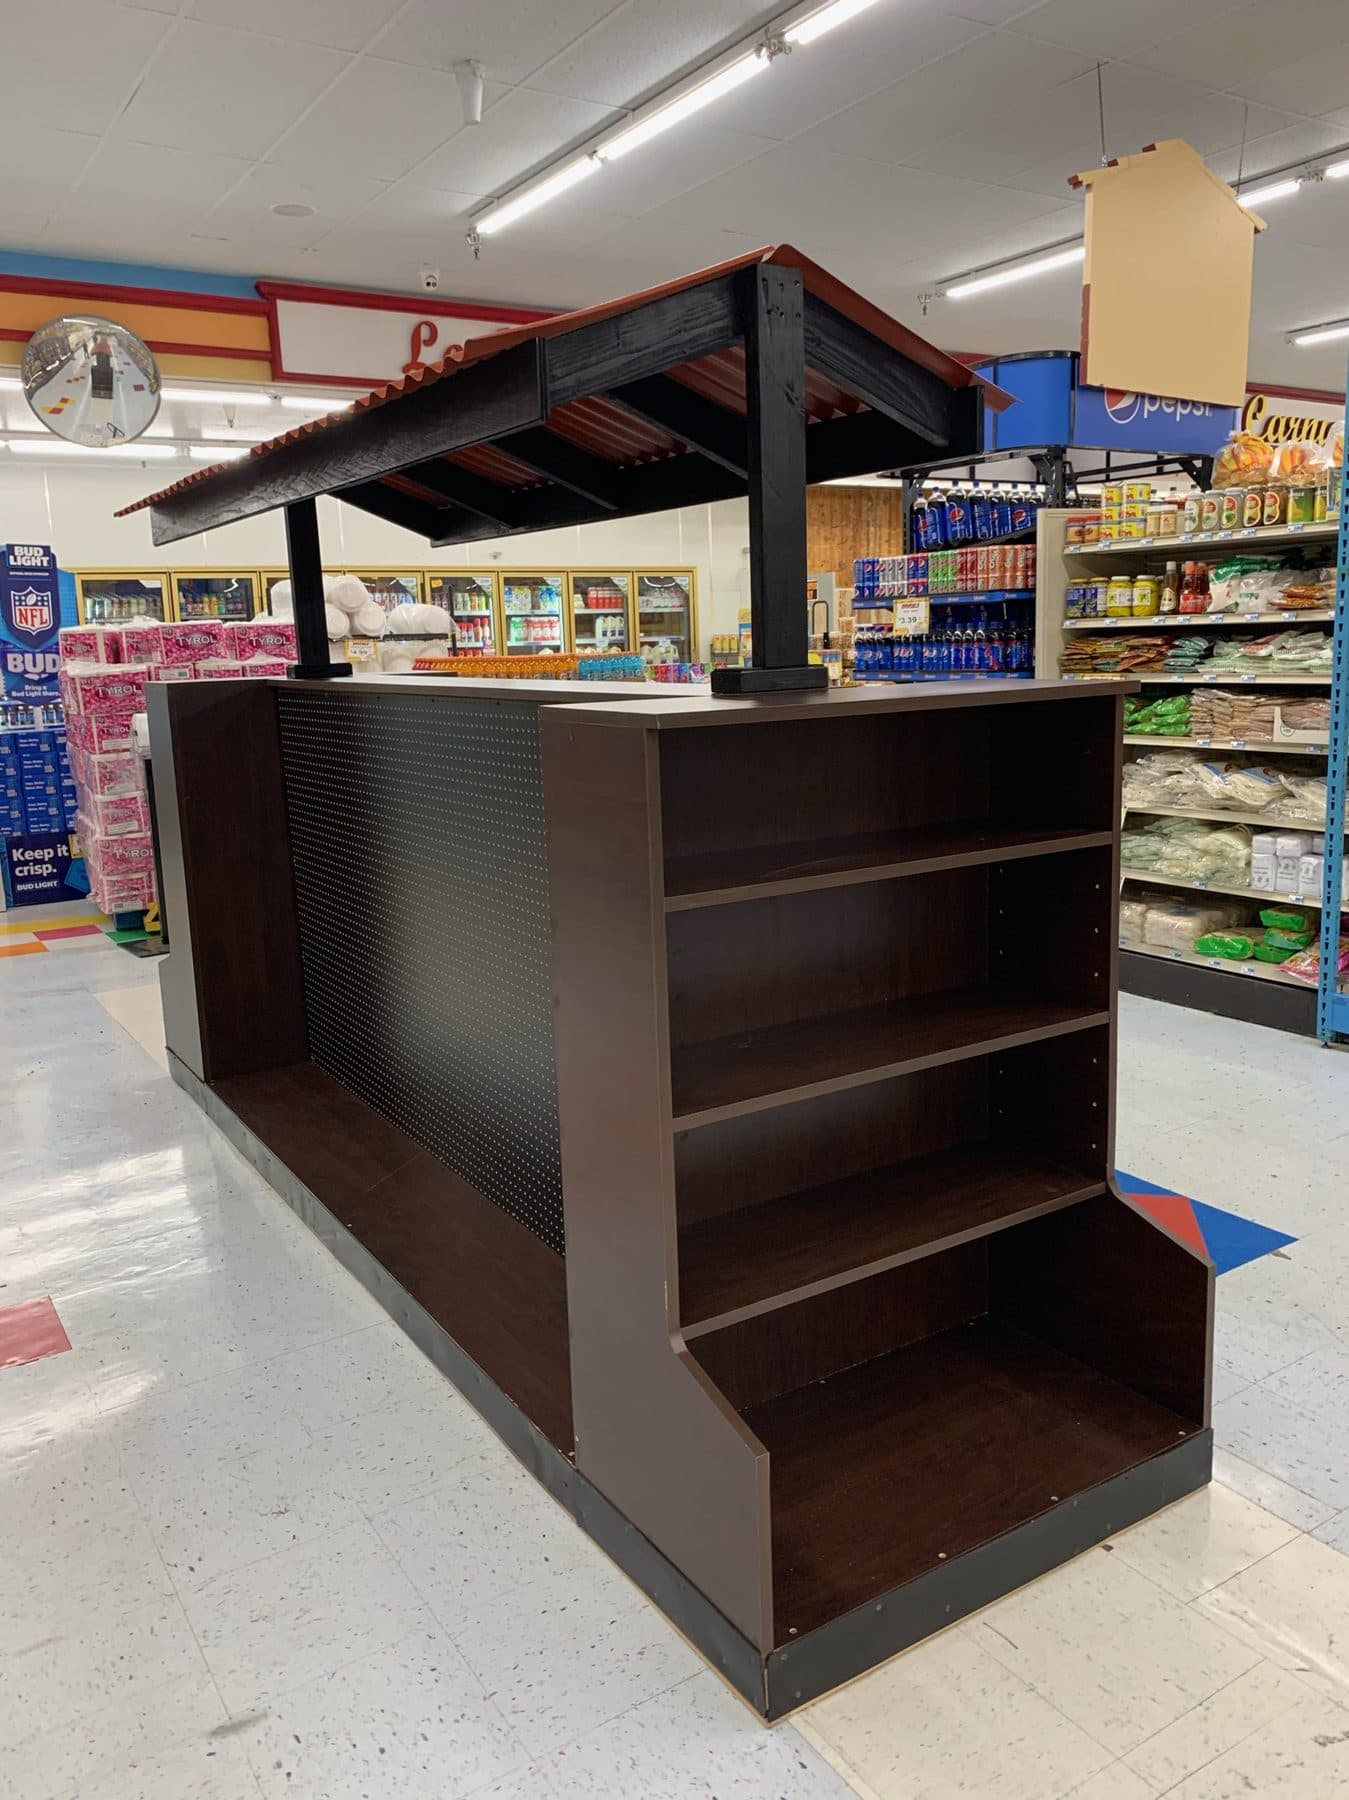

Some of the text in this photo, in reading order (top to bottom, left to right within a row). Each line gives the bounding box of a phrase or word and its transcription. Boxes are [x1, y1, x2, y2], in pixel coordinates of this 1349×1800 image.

[14, 545, 44, 557] BUD
[9, 555, 49, 567] LIGHT
[18, 607, 49, 628] NFL
[176, 633, 218, 646] TYROL
[250, 634, 290, 646] TYROL
[7, 653, 60, 674] BUD
[97, 685, 139, 697] TYROL
[12, 848, 54, 861] Keep
[57, 844, 69, 857] it
[15, 862, 57, 877] crisp.
[17, 880, 58, 891] BUD LIGHT
